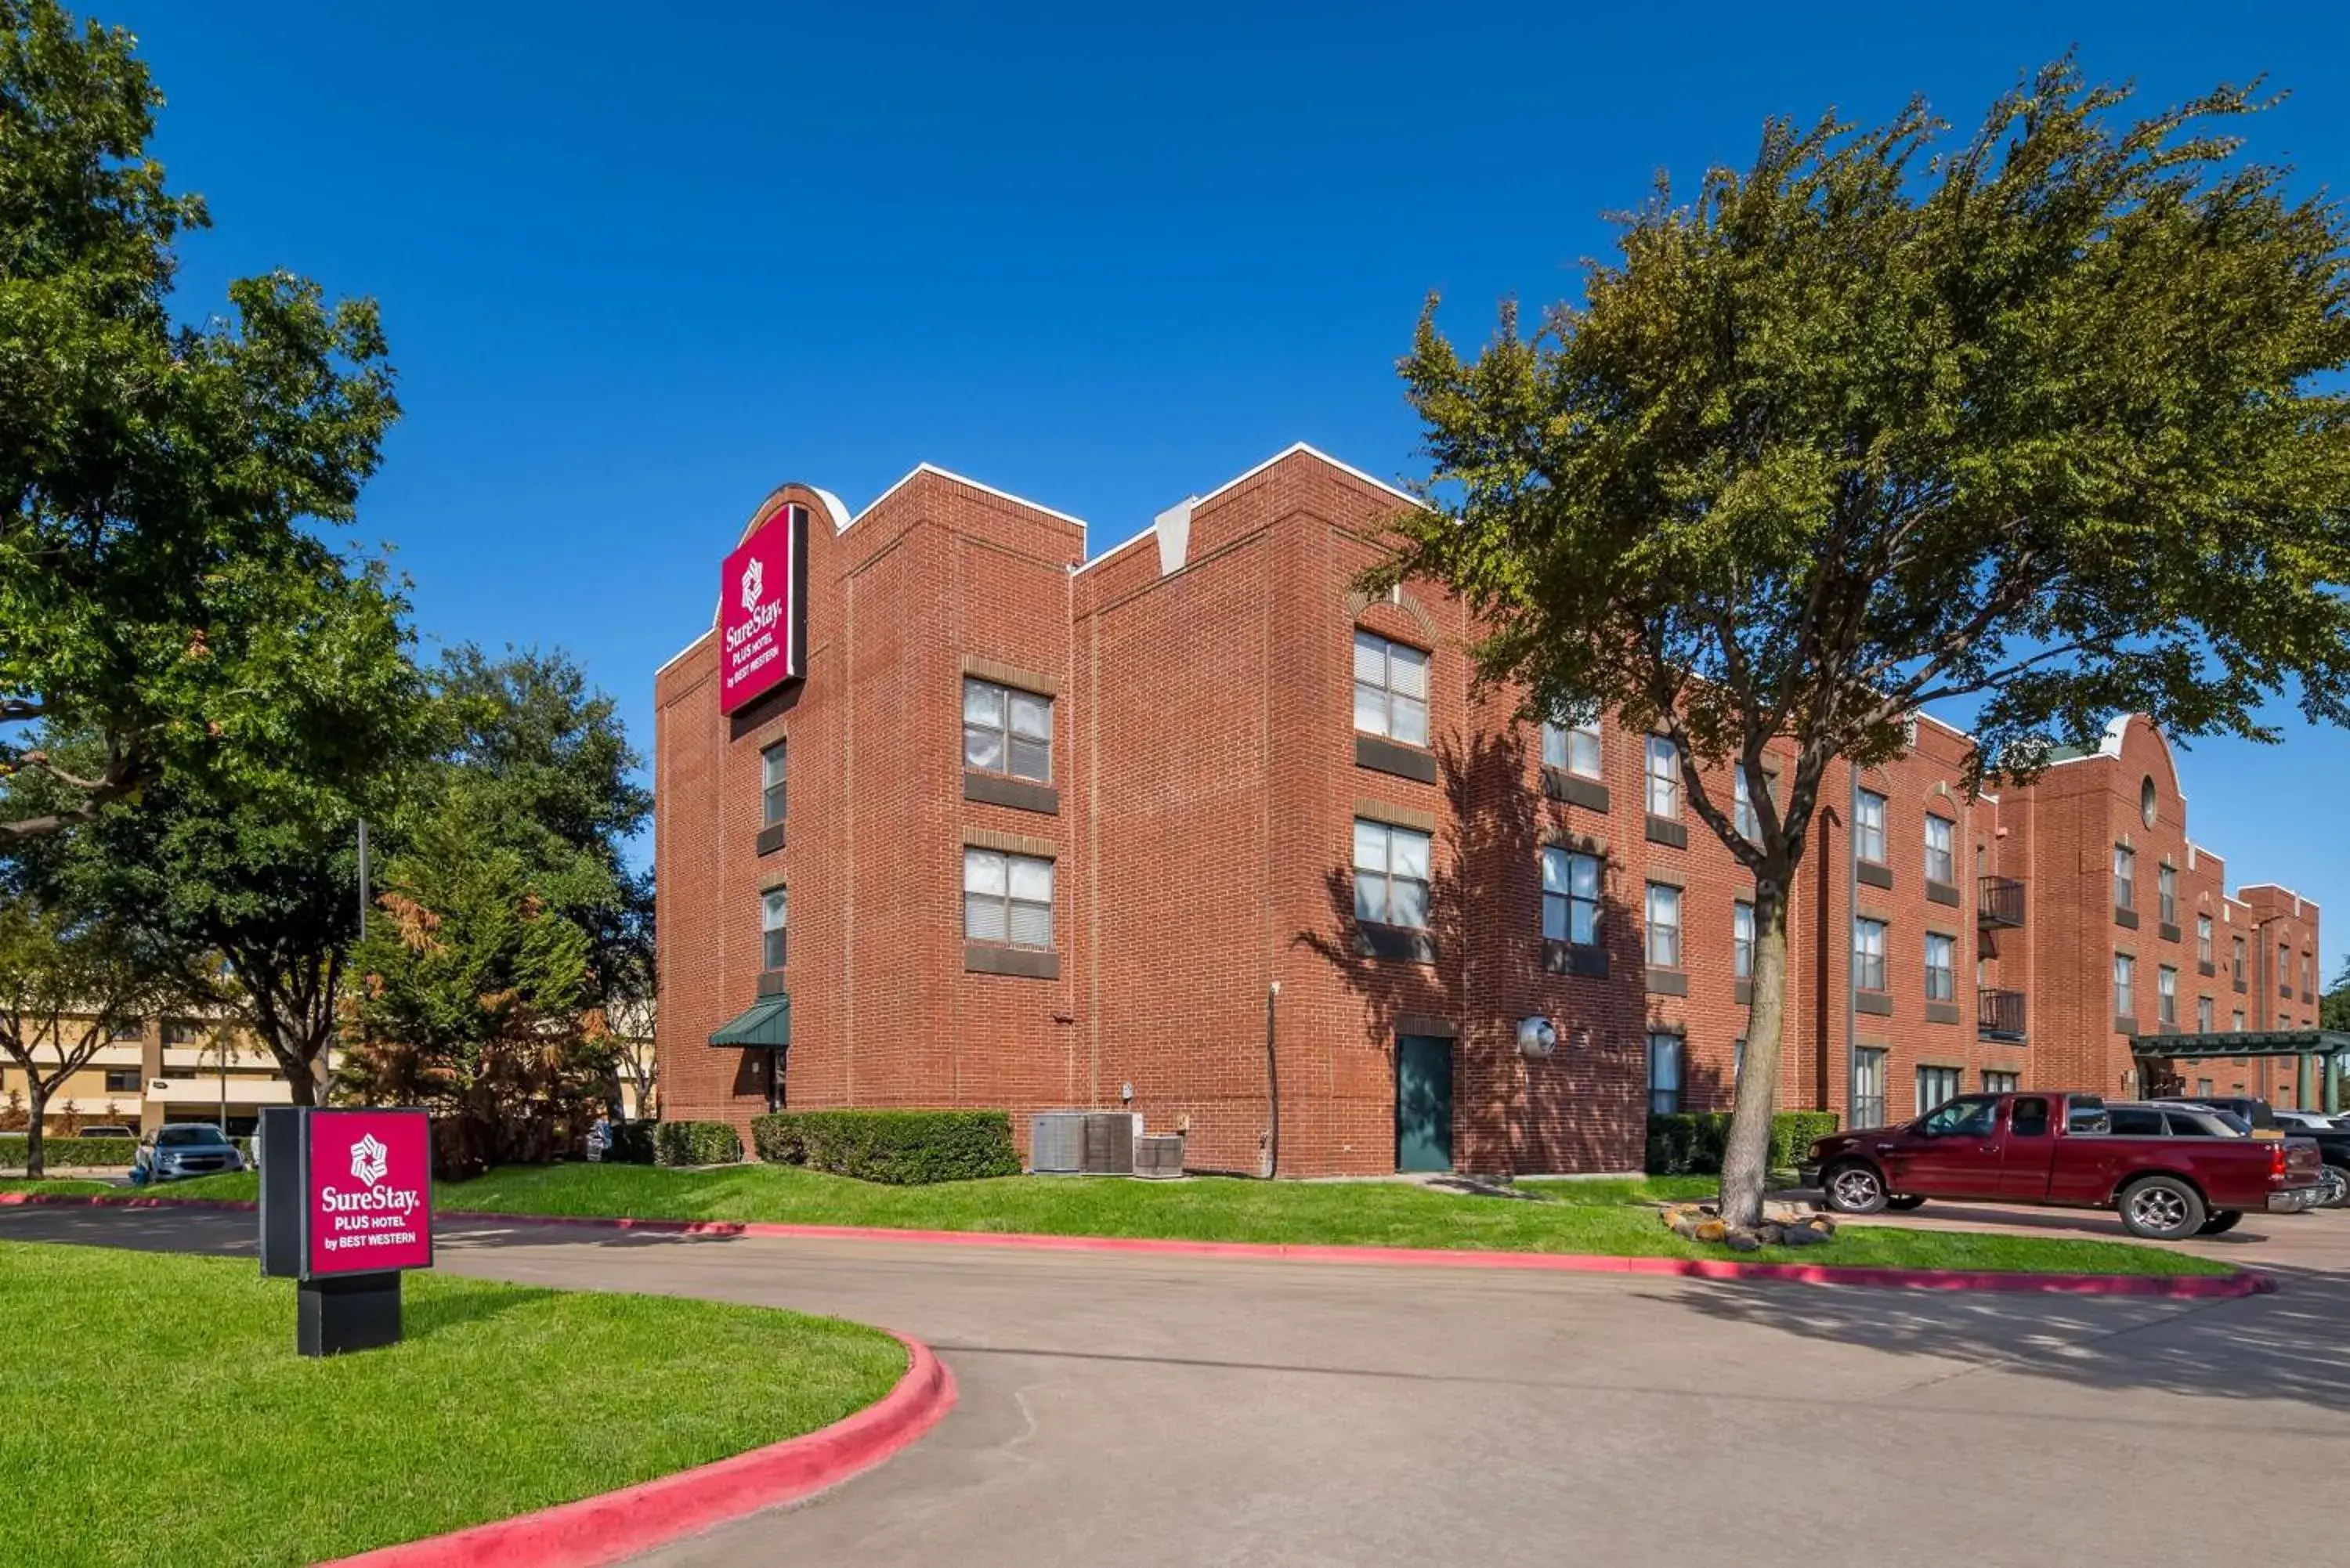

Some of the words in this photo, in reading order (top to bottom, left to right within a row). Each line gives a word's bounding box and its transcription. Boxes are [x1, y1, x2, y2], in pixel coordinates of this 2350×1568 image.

[732, 643, 751, 667] PLUS
[751, 632, 772, 654] HOTEL
[726, 677, 734, 688] by
[734, 664, 750, 684] BEST
[750, 645, 779, 672] WESTERN
[334, 1215, 369, 1230] PLUS
[371, 1216, 406, 1228] HOTEL
[324, 1237, 337, 1252] by
[339, 1235, 367, 1248] BEST
[367, 1231, 416, 1246] WESTERN
